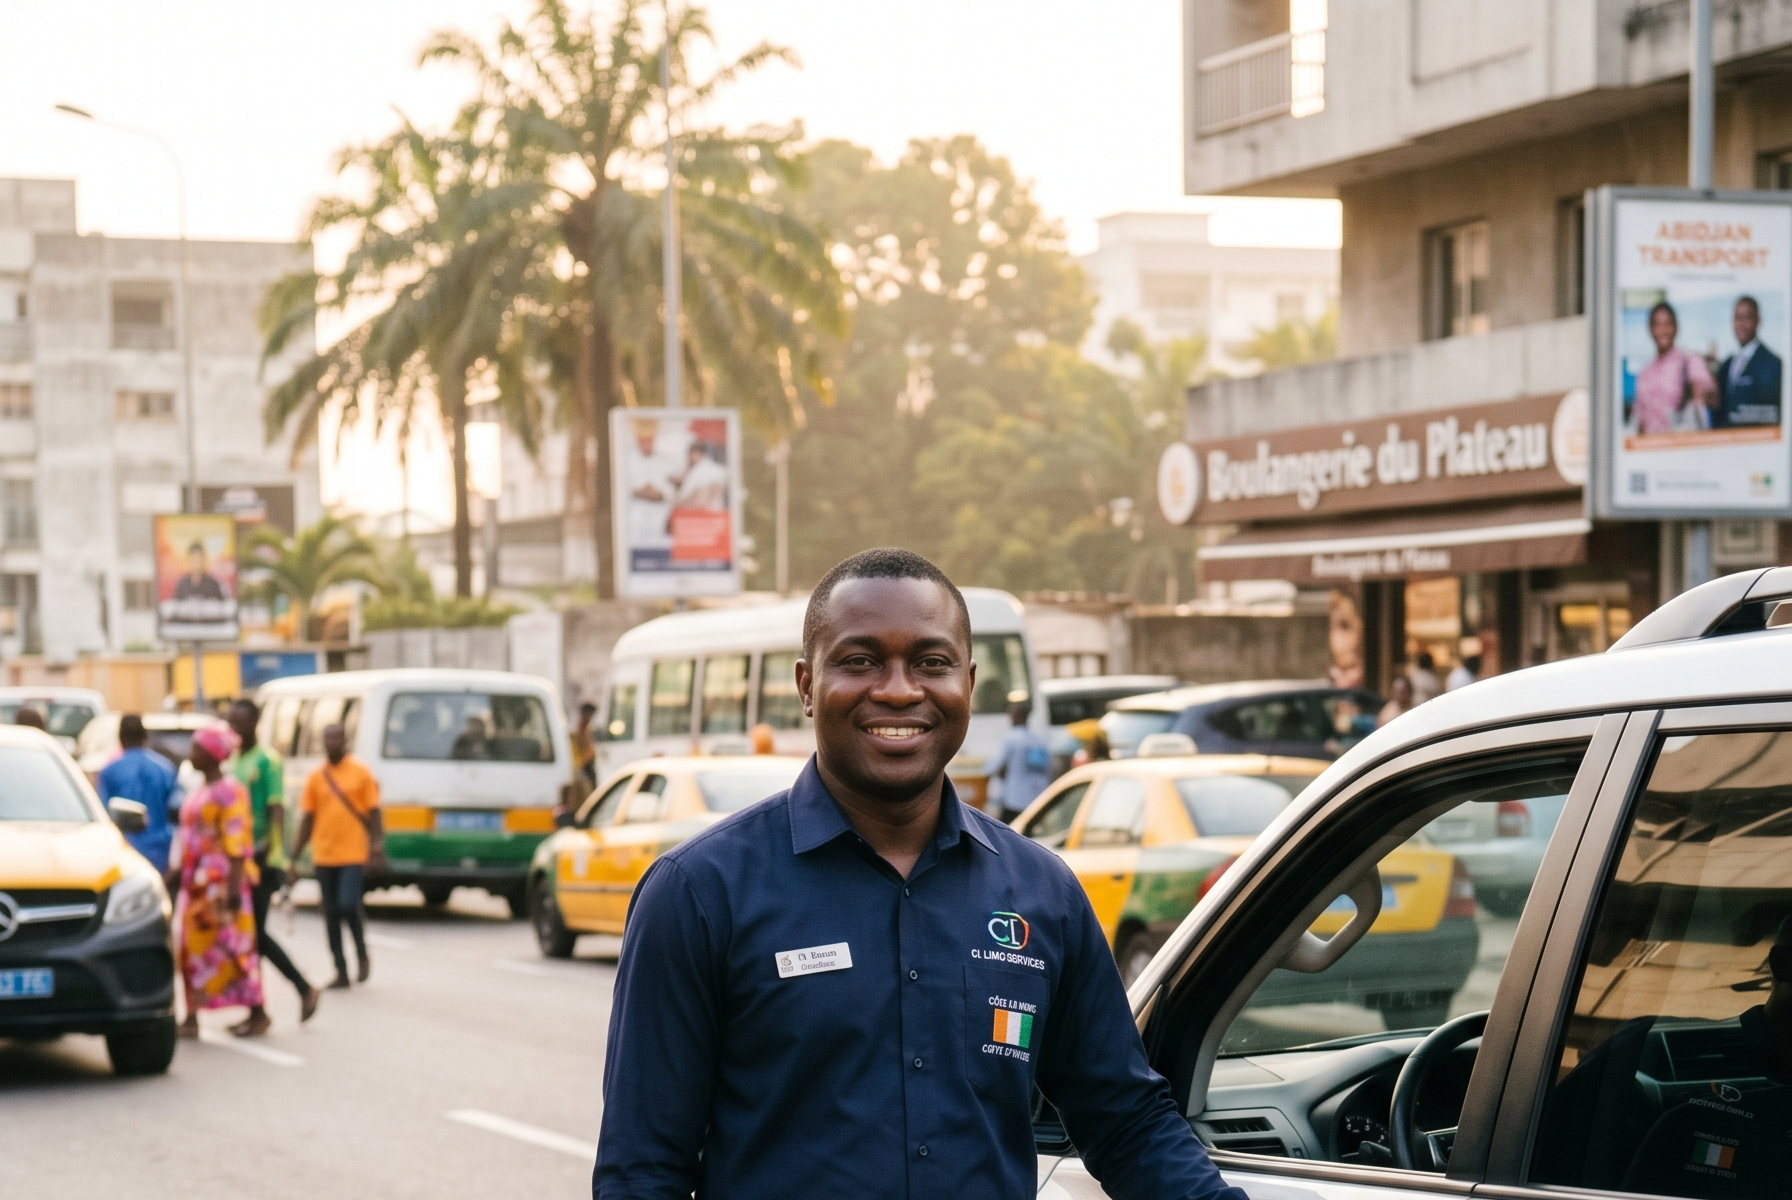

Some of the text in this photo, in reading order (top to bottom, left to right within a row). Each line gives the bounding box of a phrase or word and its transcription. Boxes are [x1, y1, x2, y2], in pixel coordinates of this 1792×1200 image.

[1656, 220, 1752, 242] ABIDJAN
[1639, 244, 1769, 268] TRANSPORT
[1208, 416, 1547, 510] Boulangerie du Plateau
[1007, 952, 1045, 970] SERVICES
